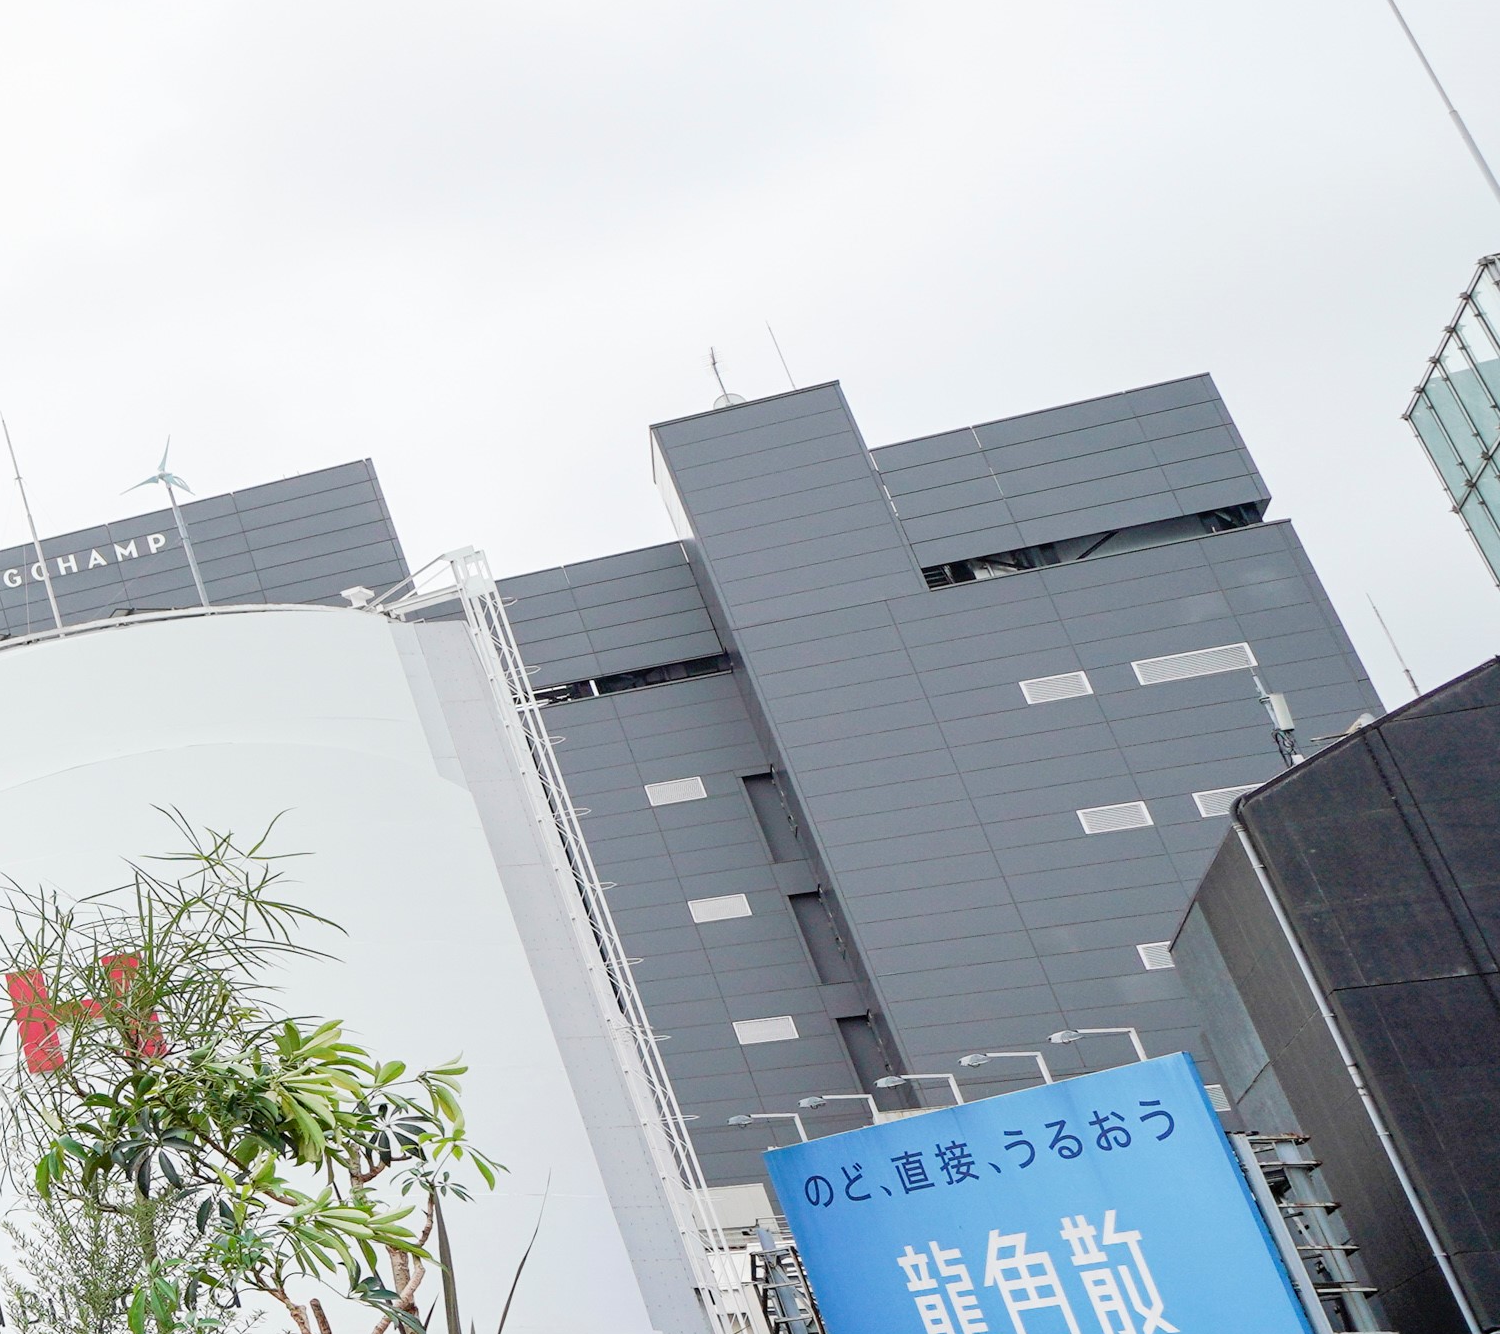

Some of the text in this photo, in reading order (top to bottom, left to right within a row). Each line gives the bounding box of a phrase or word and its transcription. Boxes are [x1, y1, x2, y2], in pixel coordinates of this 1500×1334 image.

[804, 1098, 1176, 1208] のど、直接、うるおう
